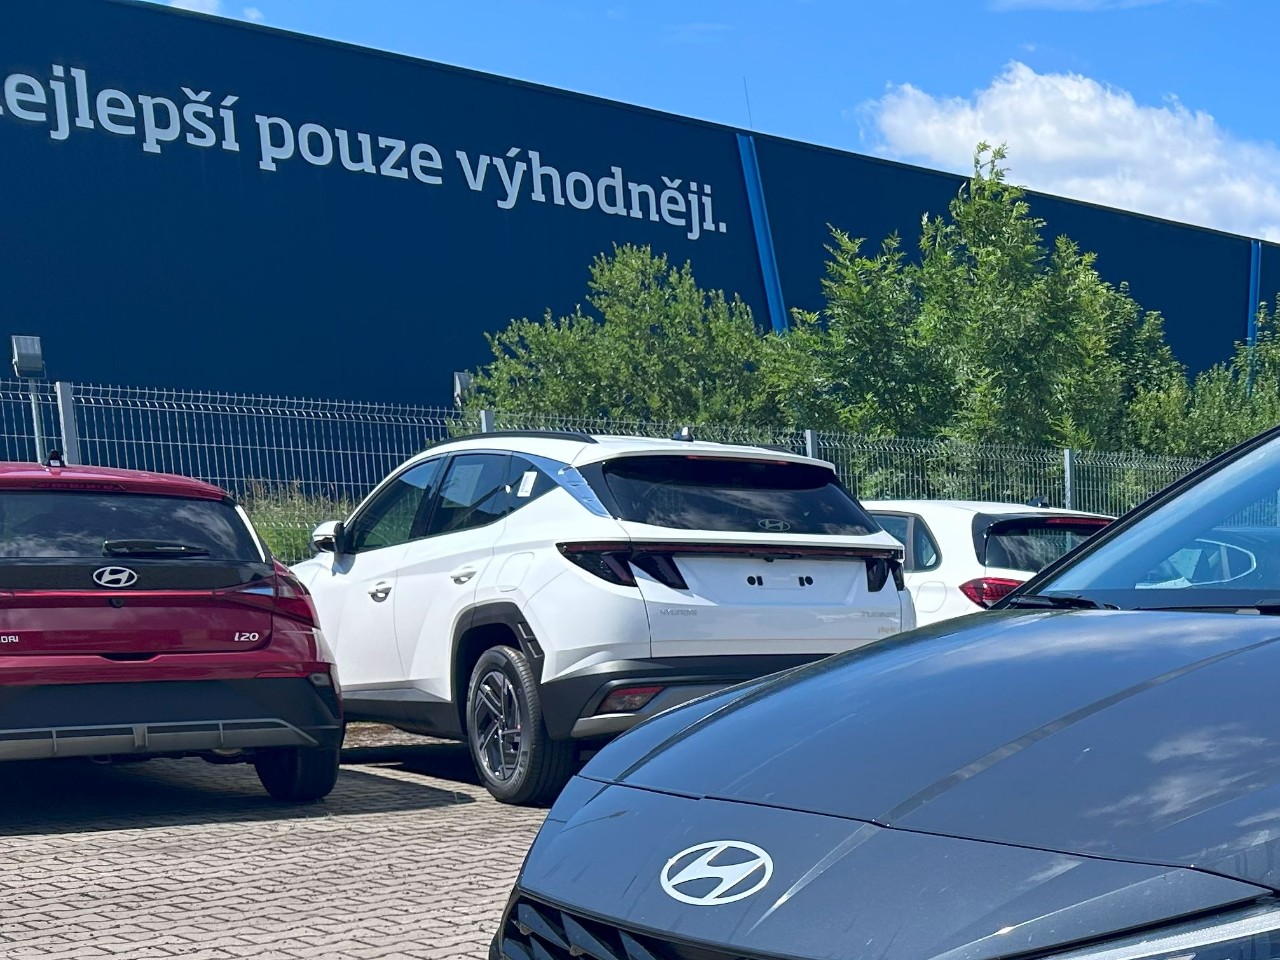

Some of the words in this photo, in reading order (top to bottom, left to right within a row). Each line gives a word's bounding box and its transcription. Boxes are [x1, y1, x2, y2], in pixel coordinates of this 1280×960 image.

[0, 63, 240, 154] ejlepší
[255, 114, 443, 185] pouze
[456, 147, 728, 241] výhodněji.
